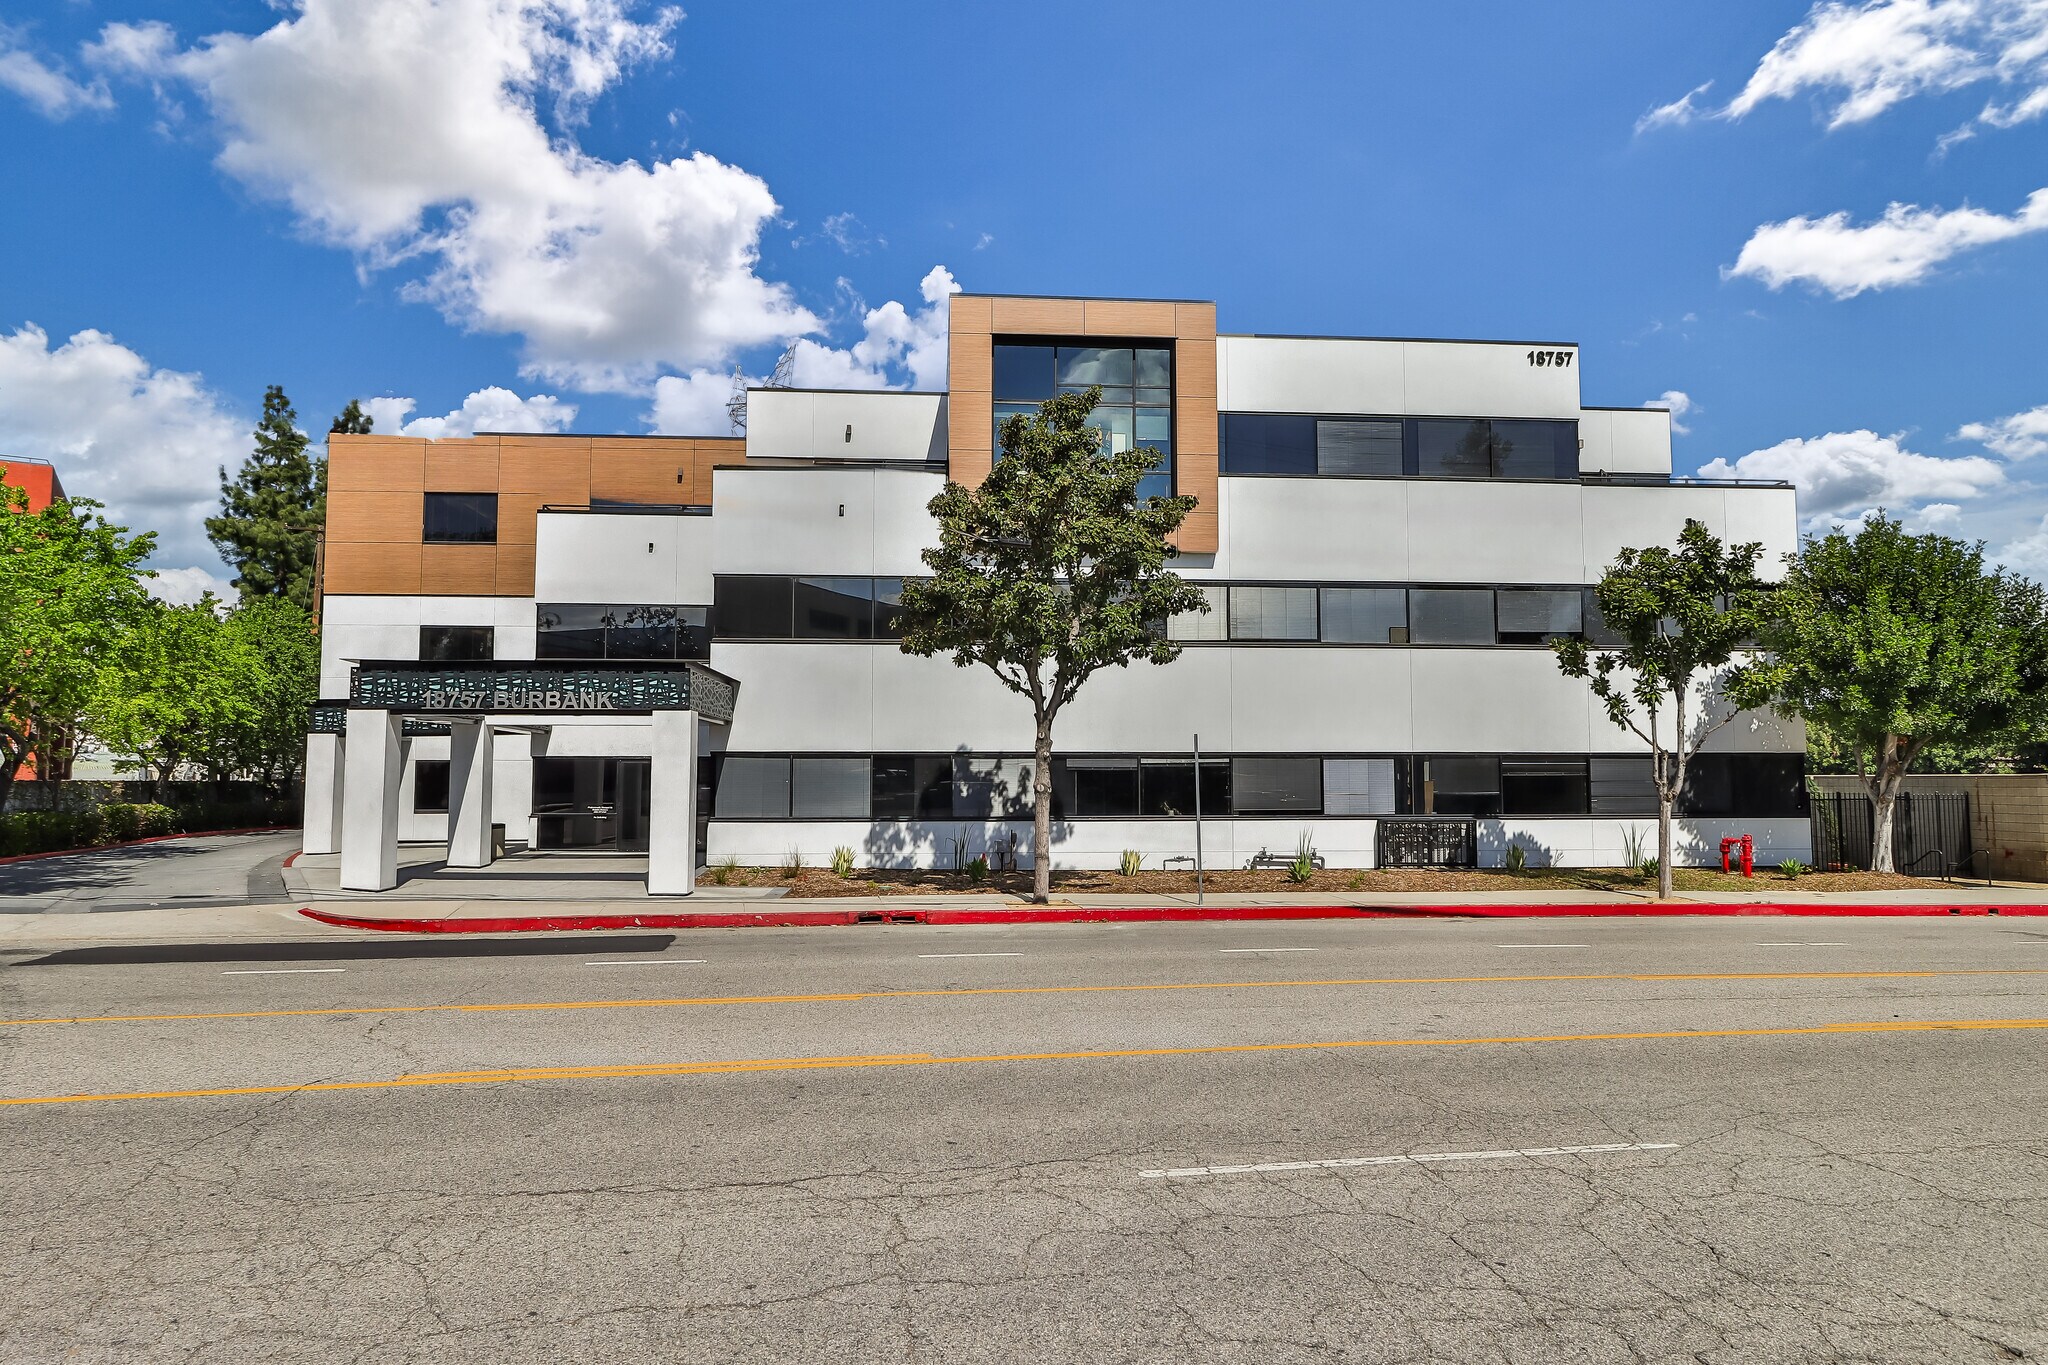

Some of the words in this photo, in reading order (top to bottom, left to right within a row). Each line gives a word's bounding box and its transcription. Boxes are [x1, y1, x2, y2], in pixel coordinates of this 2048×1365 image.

[1527, 351, 1573, 367] 18757
[421, 690, 486, 709] 18757
[493, 691, 614, 709] BURBANK
